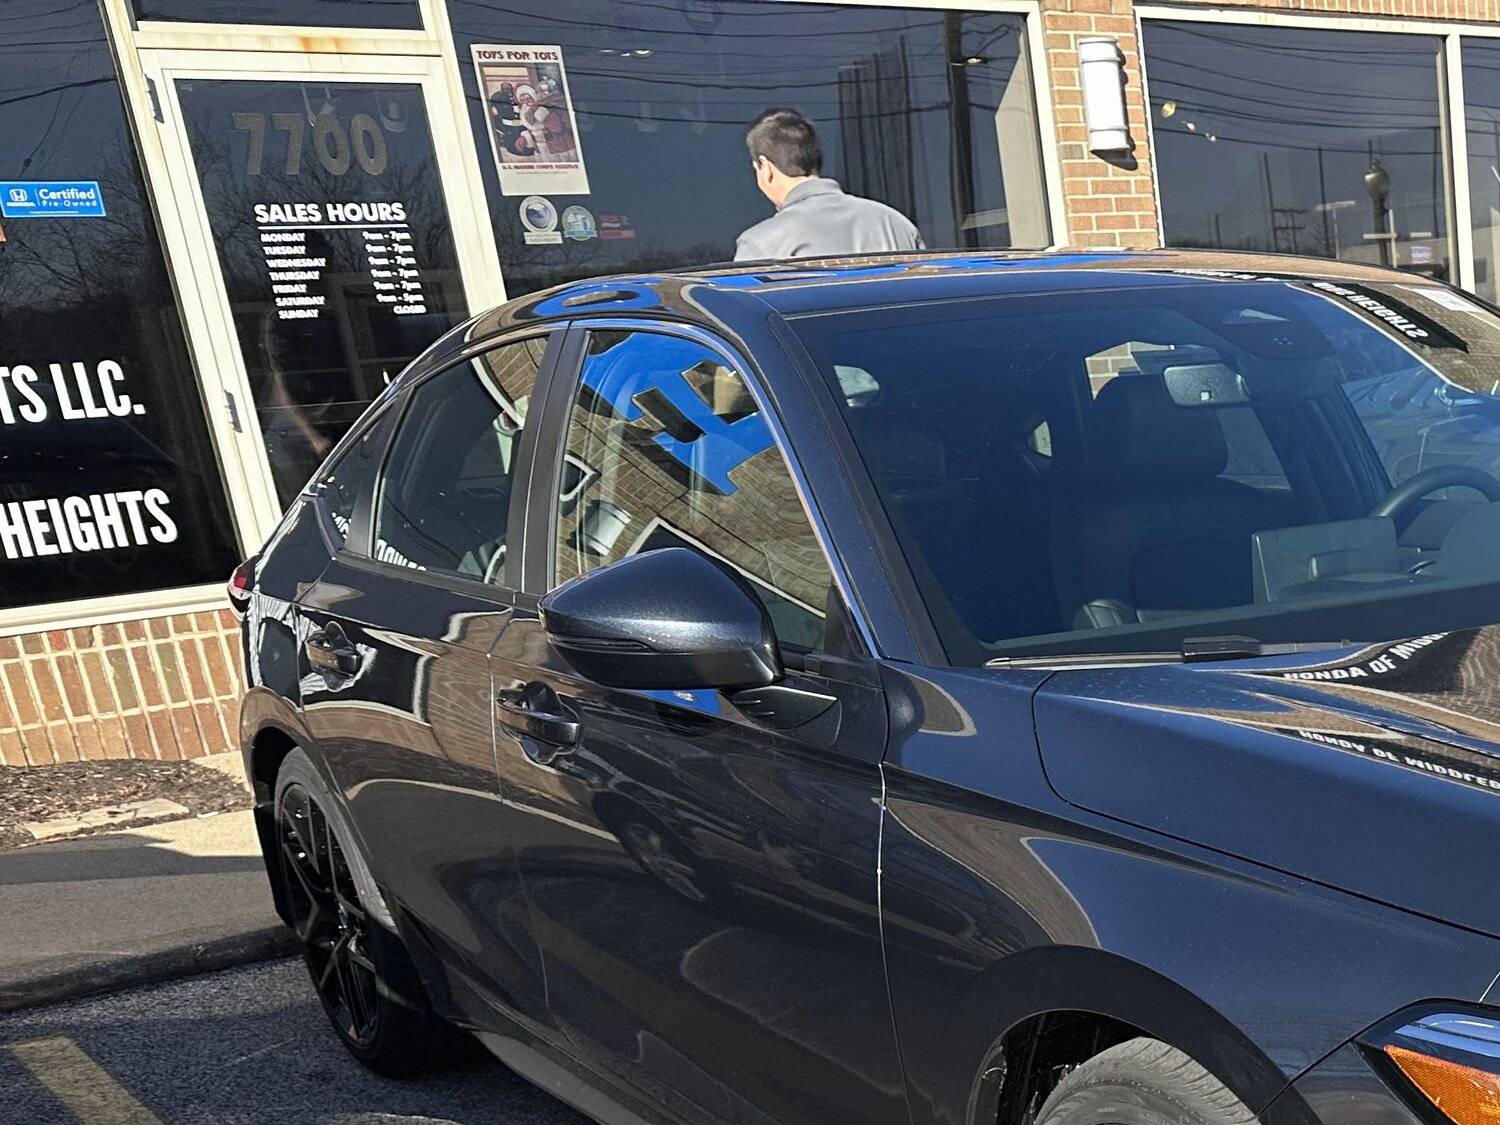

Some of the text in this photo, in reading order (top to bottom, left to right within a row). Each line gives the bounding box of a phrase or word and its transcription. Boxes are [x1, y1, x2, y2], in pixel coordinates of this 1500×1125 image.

[476, 50, 559, 61] TOYS FOR TOTS
[232, 112, 388, 176] 7700
[38, 187, 96, 200] Certified
[41, 199, 97, 208] Pre-Owned
[253, 202, 407, 224] SALES HOURS
[260, 232, 305, 242] MONDAY
[262, 245, 306, 255] TUESDAY
[265, 258, 327, 268] WEDNESDAY
[268, 270, 320, 281] THURSDAY
[272, 284, 307, 294] FRIDAY
[275, 296, 326, 307] SATURDAY
[278, 304, 427, 319] SUNDAY CLOSED
[49, 359, 146, 420] LLC.
[0, 488, 178, 560] HEIGHTS
[1368, 654, 1397, 674] OF
